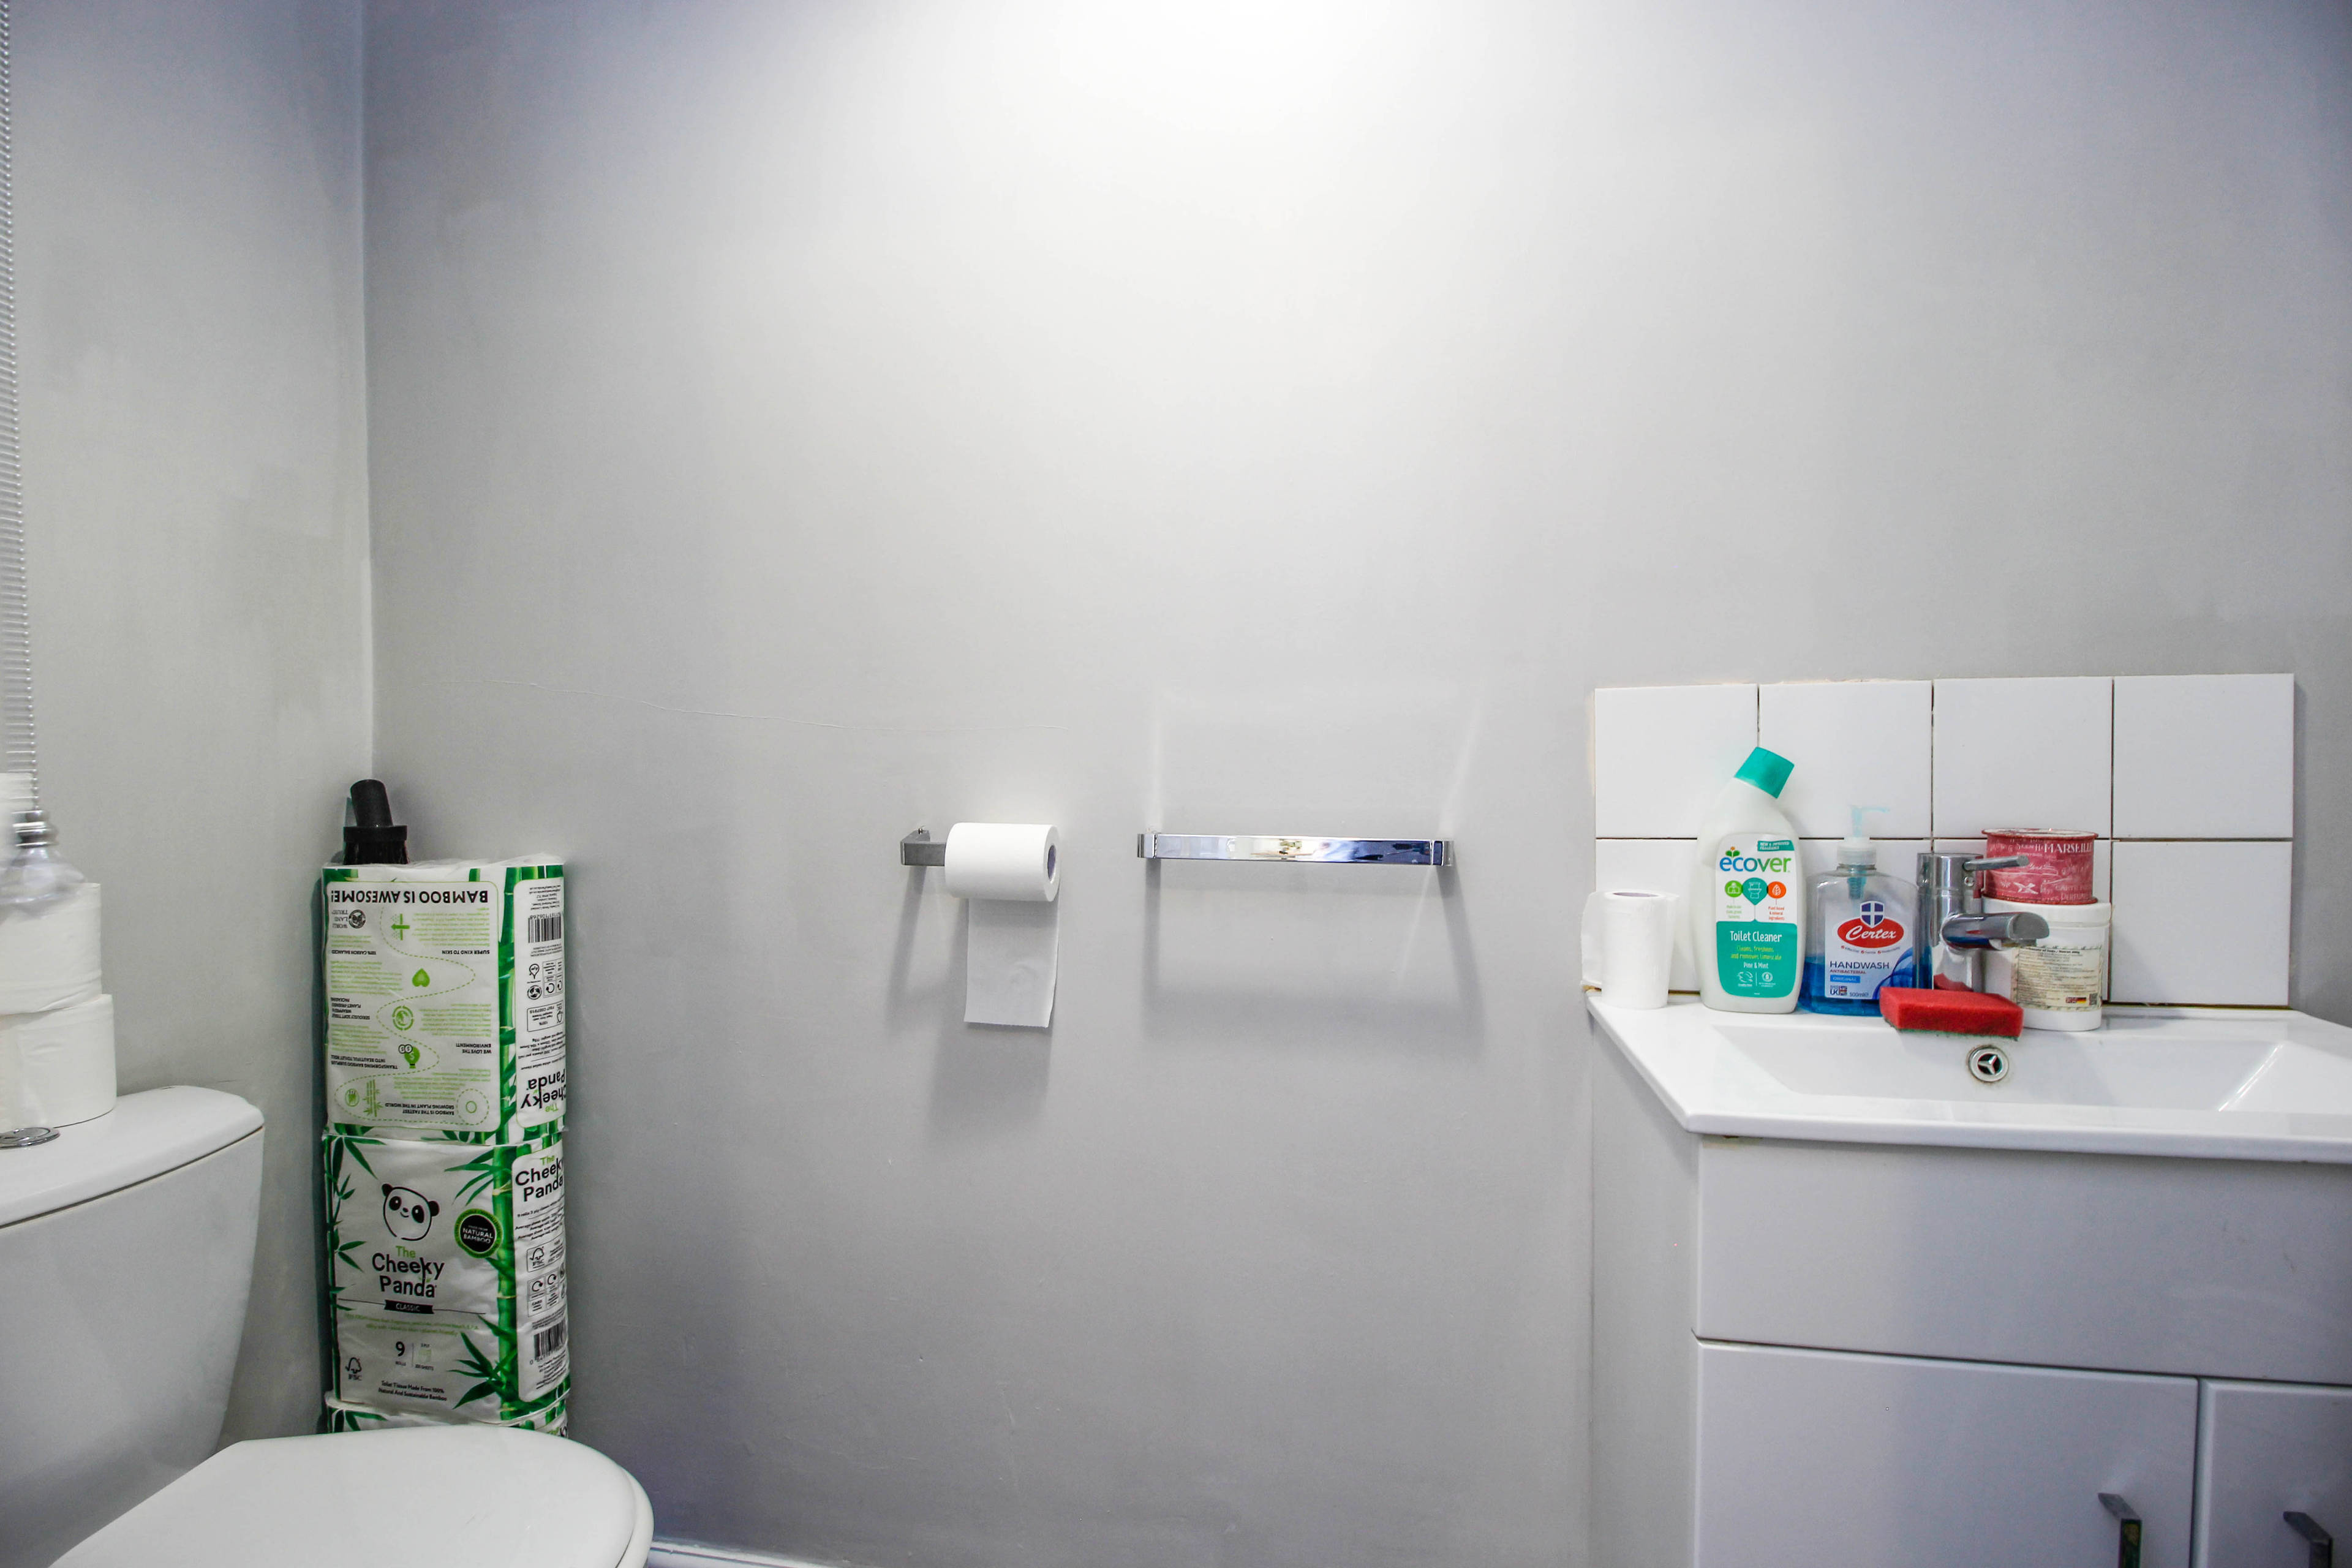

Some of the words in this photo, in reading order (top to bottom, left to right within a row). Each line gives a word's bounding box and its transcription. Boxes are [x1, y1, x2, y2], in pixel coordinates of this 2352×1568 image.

[1719, 856, 1792, 873] ecover
[331, 890, 401, 903] AWESOME!
[403, 891, 415, 903] IS
[419, 891, 488, 903] BAMBOO
[1730, 930, 1751, 941] Toilet
[1752, 931, 1782, 942] Cleaner
[1845, 925, 1897, 941] Certex
[1830, 960, 1890, 970] HANDWASH
[527, 1068, 565, 1090] Panda
[545, 1103, 559, 1112] The
[540, 1155, 555, 1166] The
[515, 1158, 564, 1186] Cheek
[462, 1227, 493, 1238] NATURAL
[396, 1245, 416, 1258] The
[372, 1252, 445, 1280] Cheeky
[379, 1275, 435, 1298] Panda
[396, 1302, 421, 1311] CLASSIC
[395, 1341, 405, 1357] 9
